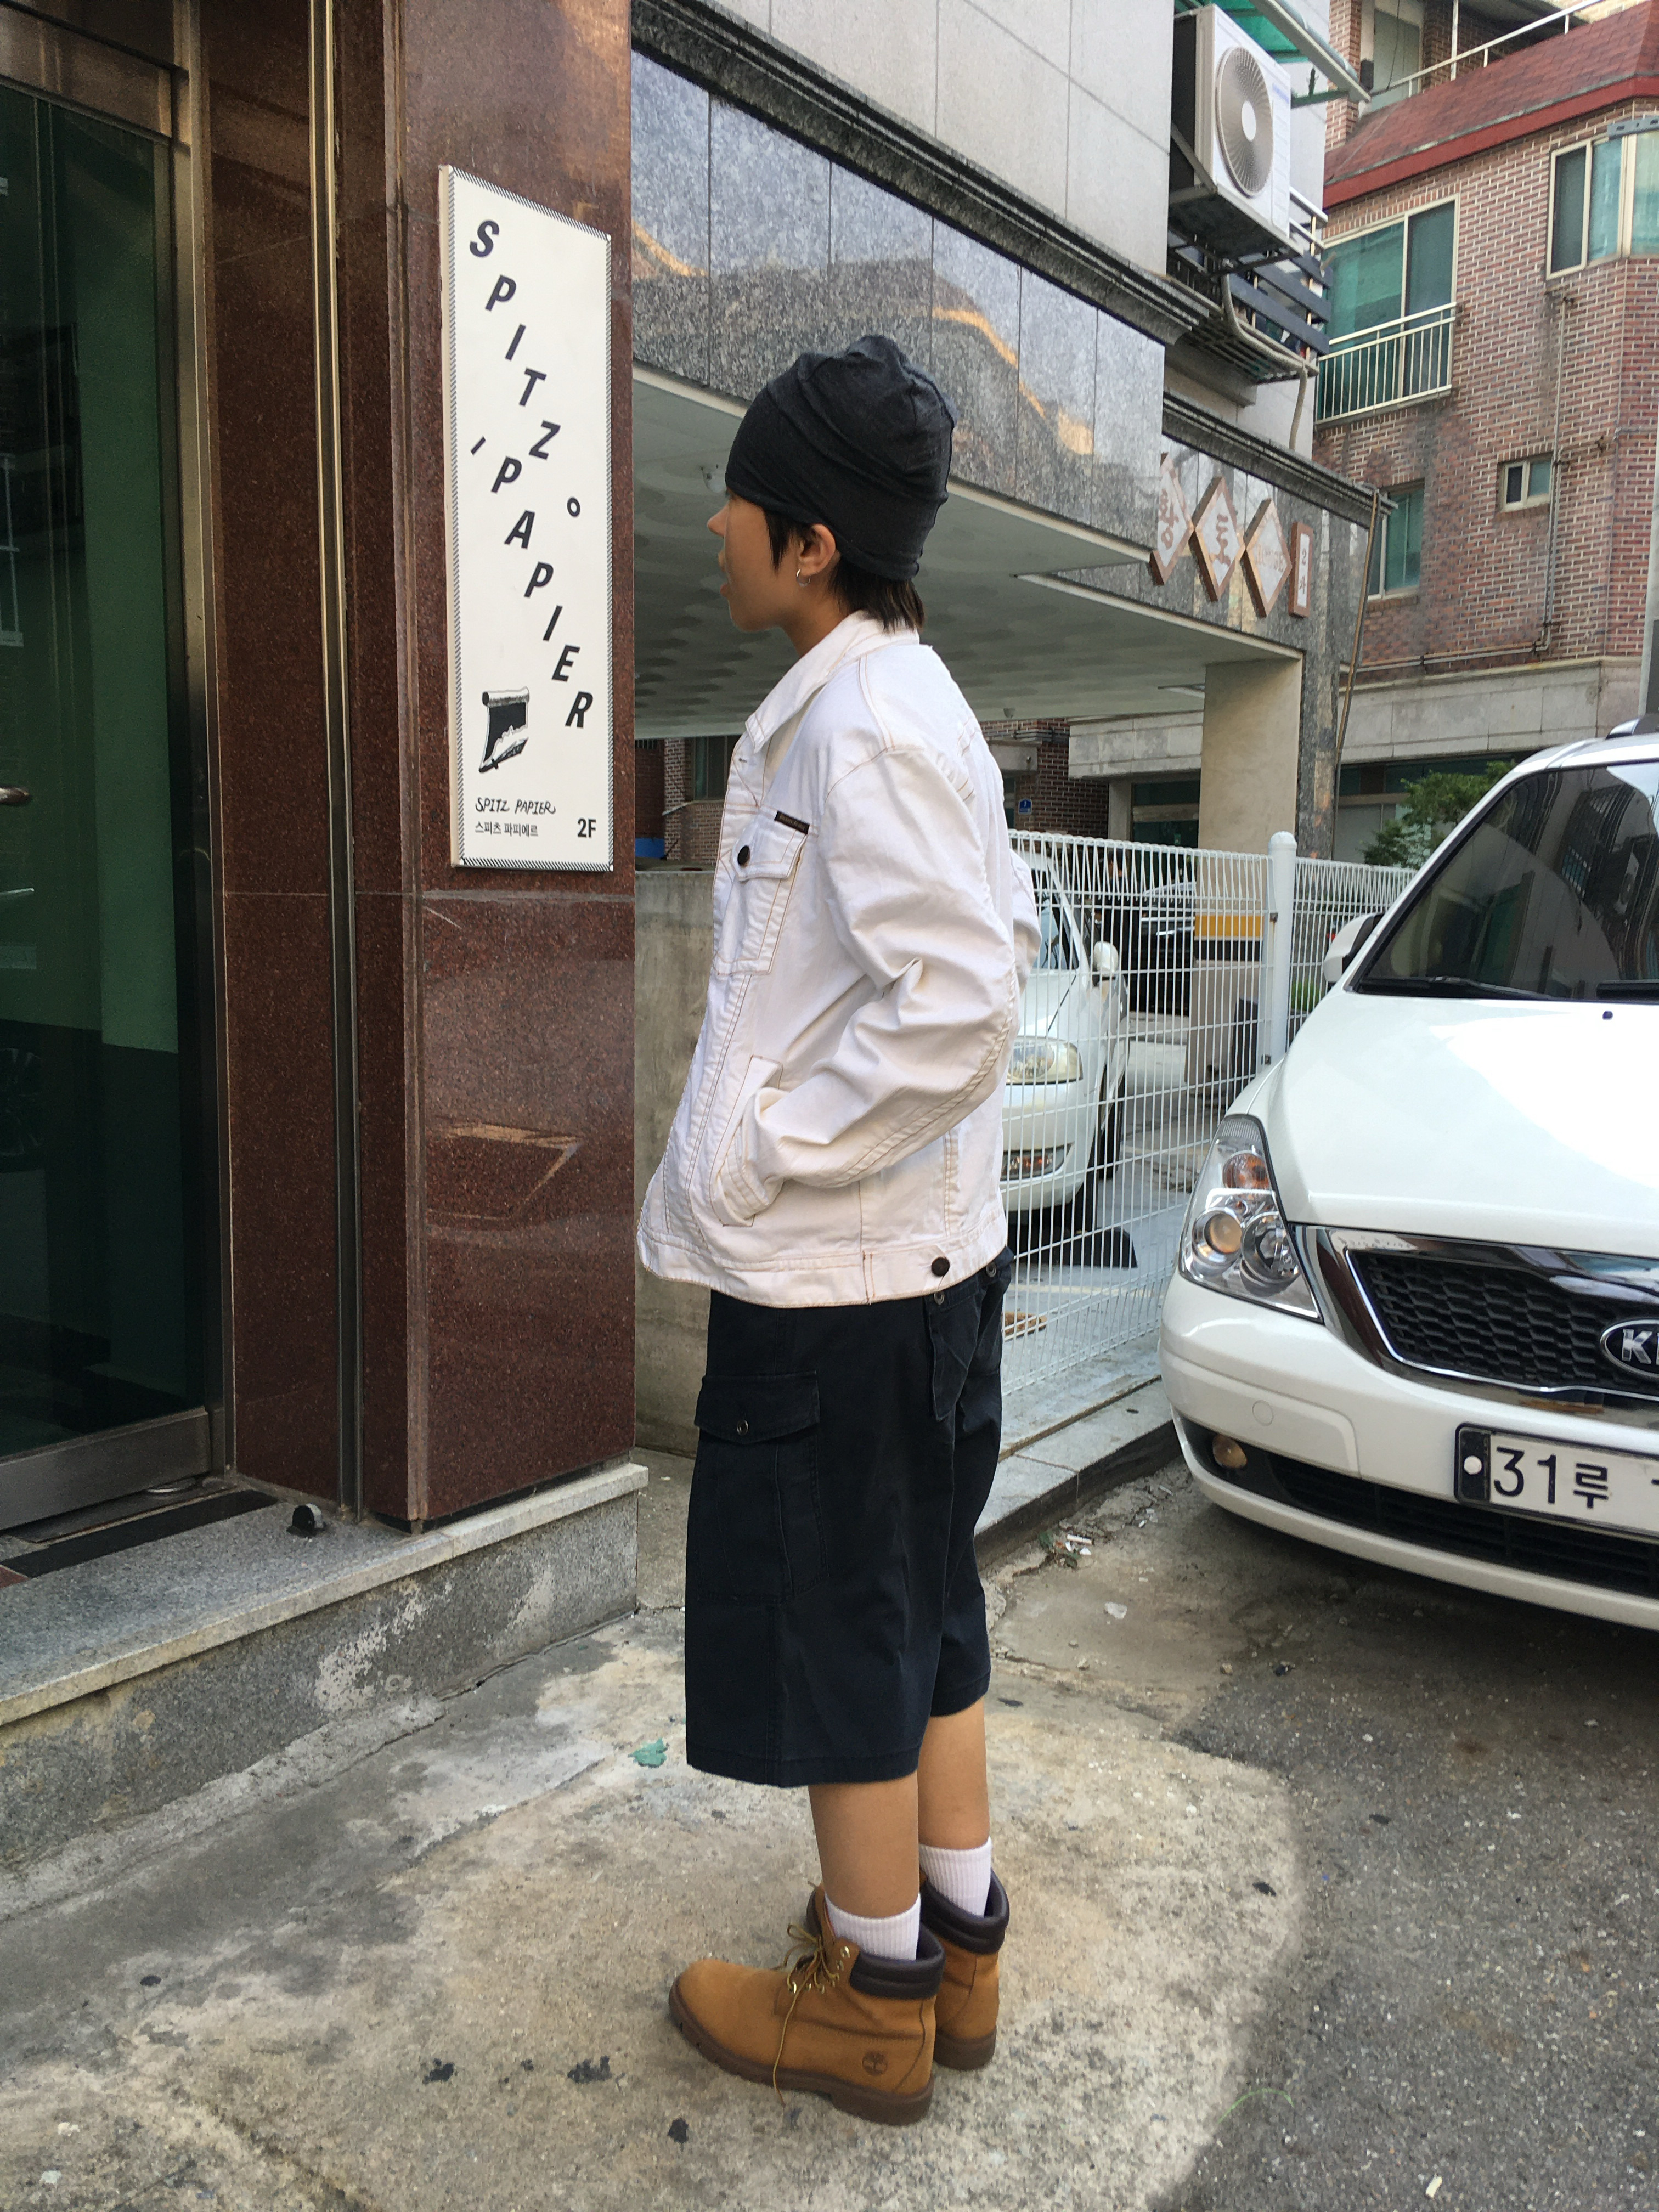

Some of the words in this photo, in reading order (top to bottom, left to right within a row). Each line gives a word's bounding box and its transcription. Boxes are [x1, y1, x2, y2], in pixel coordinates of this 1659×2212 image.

[475, 797, 510, 813] SPITZ
[514, 799, 556, 815] PAPIER
[475, 821, 502, 835] 스피츠
[504, 823, 539, 838] 파피에르
[577, 817, 597, 839] 2F
[1494, 1446, 1609, 1509] 31루
